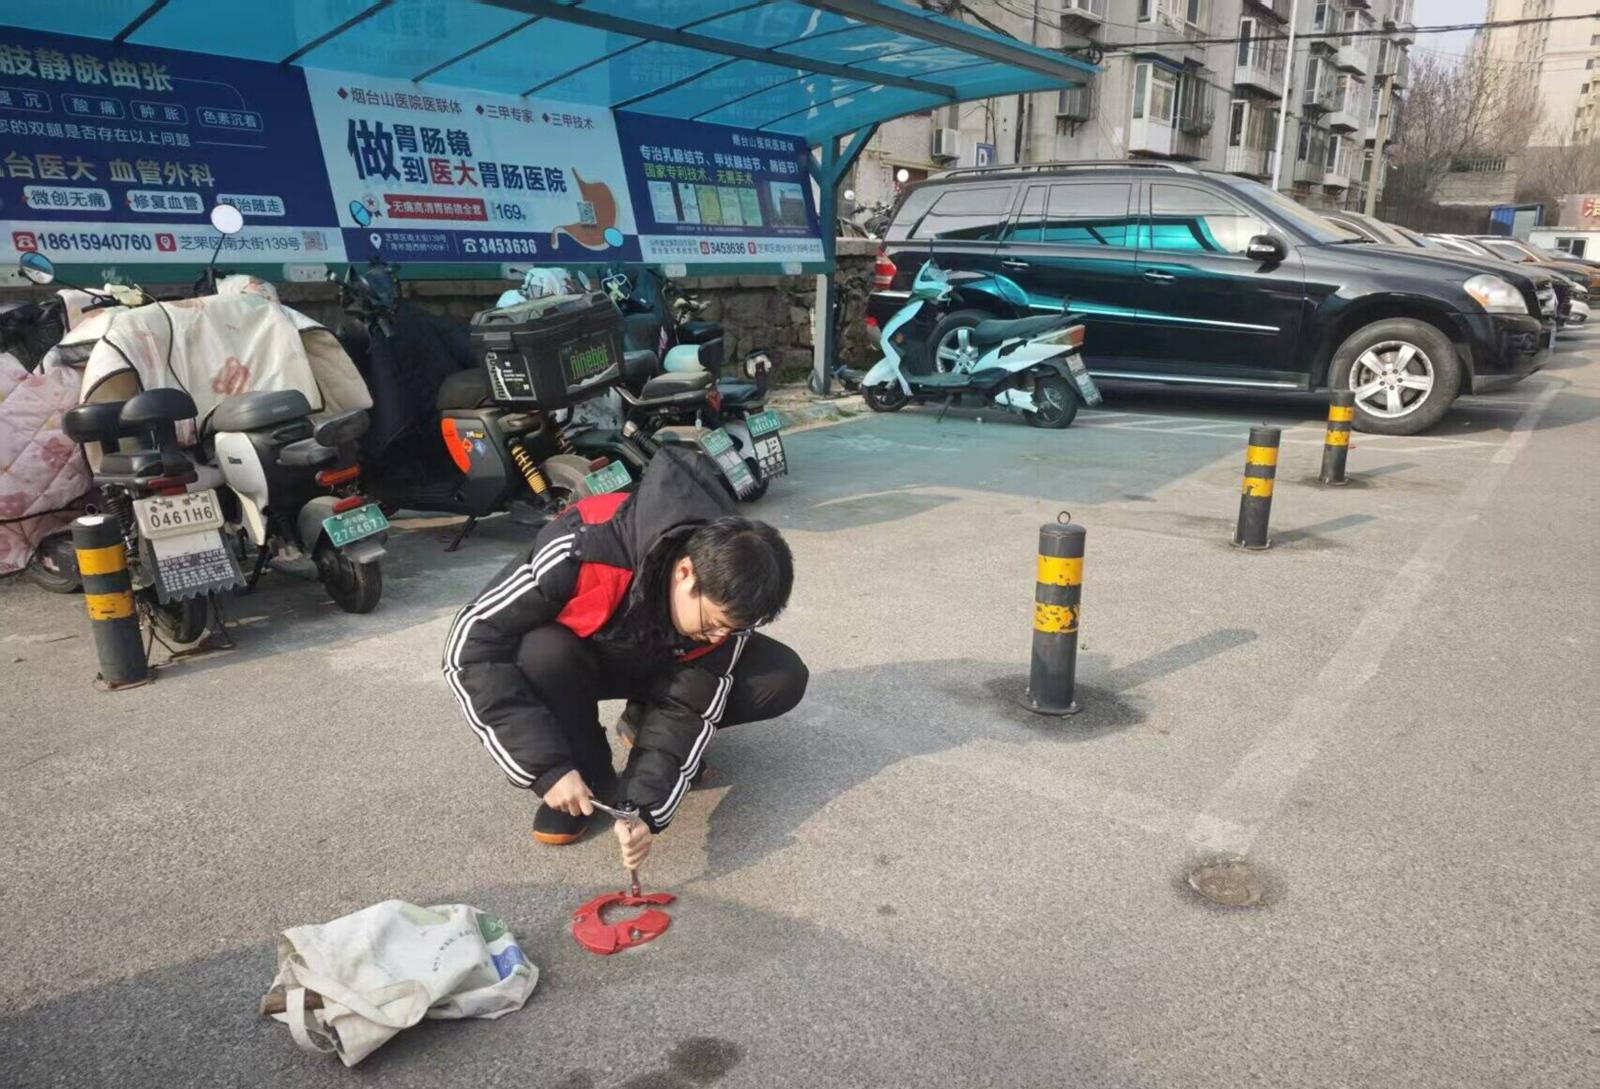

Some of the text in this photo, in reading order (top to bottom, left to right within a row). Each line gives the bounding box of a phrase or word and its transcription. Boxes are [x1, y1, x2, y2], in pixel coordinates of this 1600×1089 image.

[350, 86, 595, 130] 烟台山医院医联体 三甲专家 三甲技术
[346, 117, 402, 182] 做
[392, 123, 473, 158] 胃肠镜
[0, 151, 216, 188] 台医大 血管外科
[400, 155, 568, 194] 到医大胃肠医院
[133, 193, 199, 212] 修复血管
[37, 231, 152, 251] 18615940760
[478, 237, 538, 255] 3453636
[710, 242, 746, 255] 3453636
[150, 506, 214, 529] 0461H6
